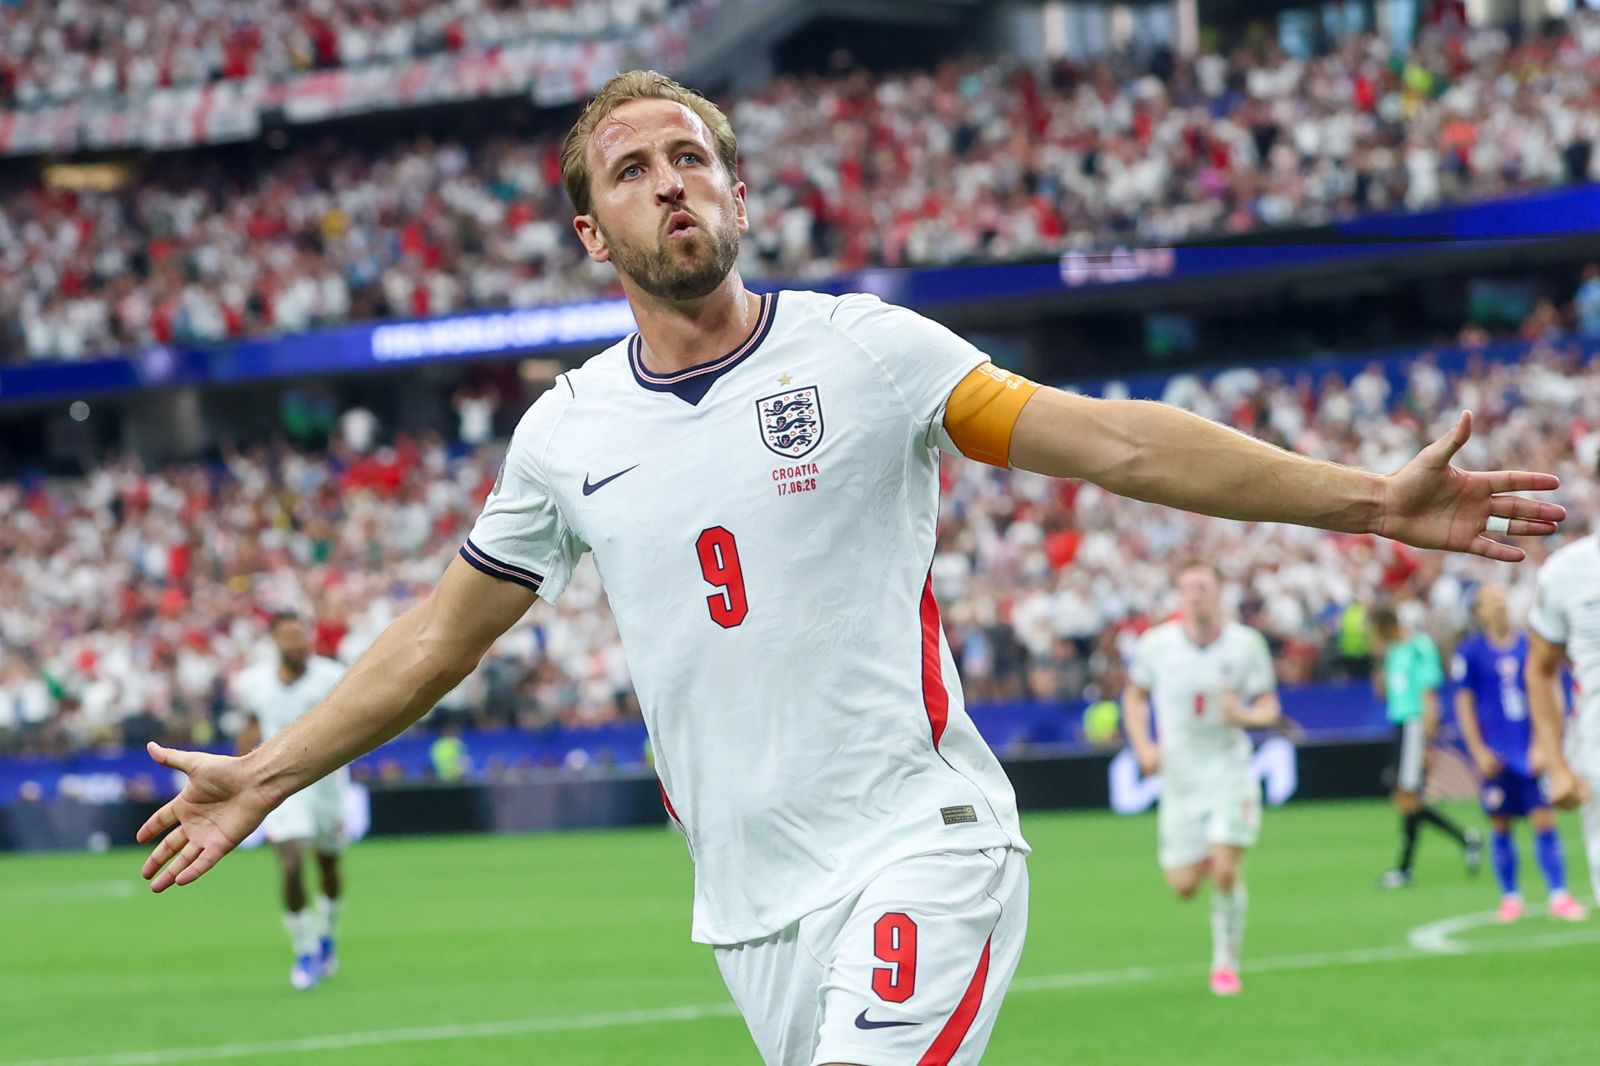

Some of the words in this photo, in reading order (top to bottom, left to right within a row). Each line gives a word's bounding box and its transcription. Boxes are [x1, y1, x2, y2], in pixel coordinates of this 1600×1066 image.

[772, 463, 819, 481] CROATIA
[777, 478, 817, 496] 17.06.26
[695, 525, 749, 629] 9
[871, 912, 918, 1004] 9
